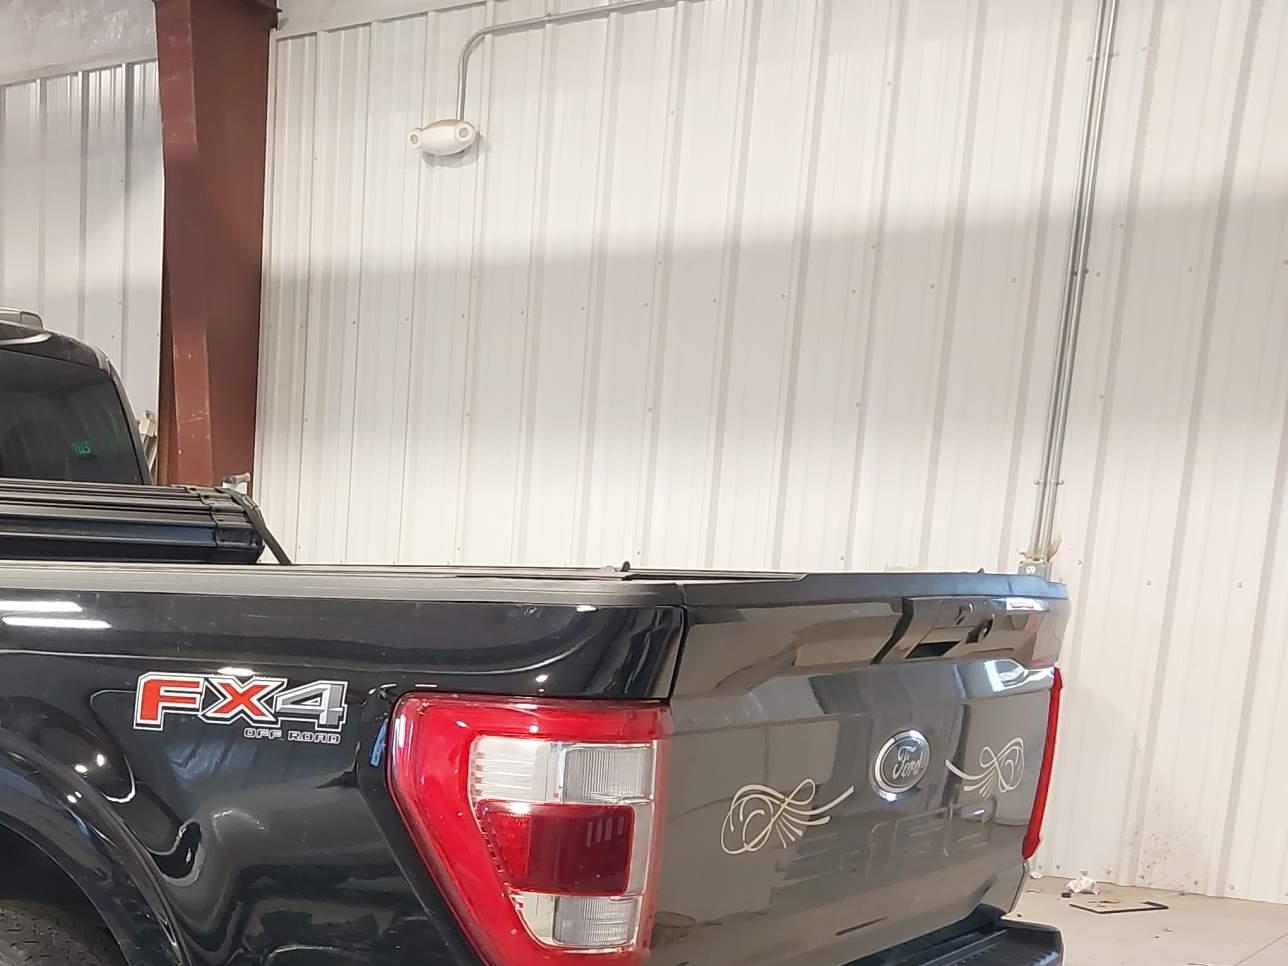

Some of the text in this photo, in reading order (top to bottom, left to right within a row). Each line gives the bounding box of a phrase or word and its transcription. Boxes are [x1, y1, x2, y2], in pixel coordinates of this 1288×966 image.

[133, 671, 349, 732] FX4
[243, 727, 341, 744] OFF ROAD
